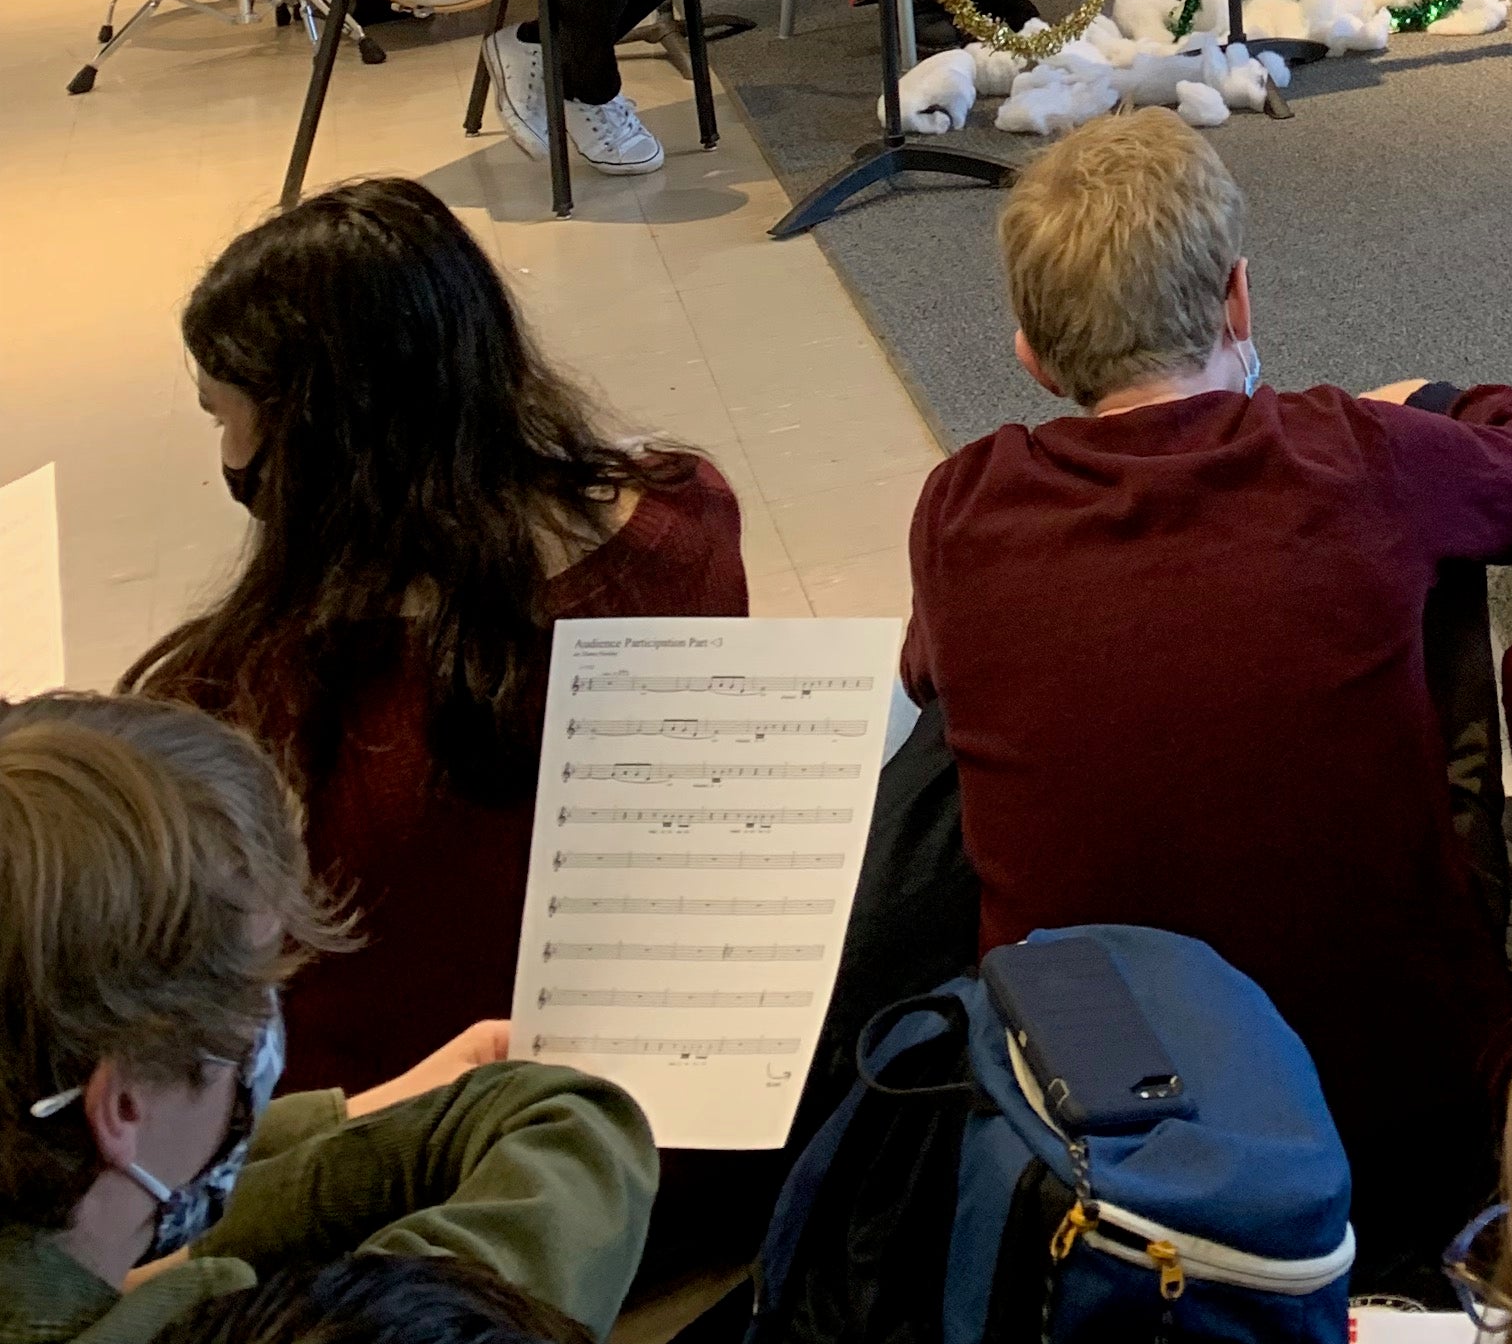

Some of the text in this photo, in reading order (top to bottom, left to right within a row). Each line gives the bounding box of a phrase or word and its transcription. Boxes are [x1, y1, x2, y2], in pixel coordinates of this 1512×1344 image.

[574, 637, 622, 649] Audience
[624, 637, 687, 650] Participation
[688, 637, 708, 648] Part
